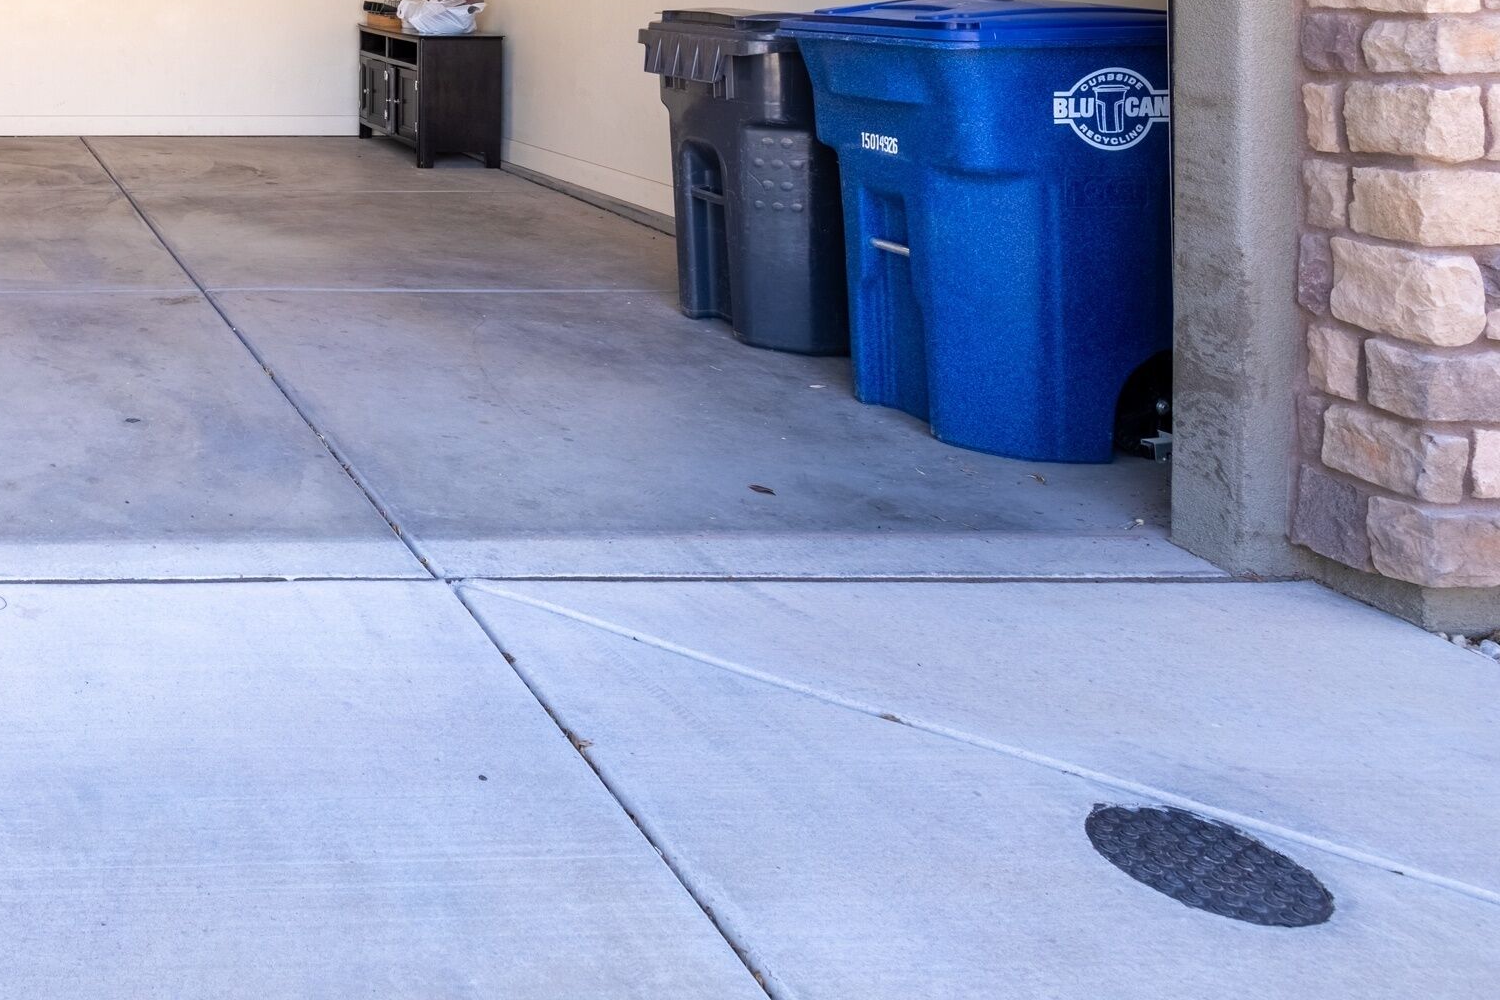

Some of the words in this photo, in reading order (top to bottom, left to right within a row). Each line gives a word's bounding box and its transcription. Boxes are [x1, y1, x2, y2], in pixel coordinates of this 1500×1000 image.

[1080, 73, 1143, 92] CURBSIDE
[1053, 97, 1095, 118] BLU
[861, 131, 898, 154] 15014926
[1079, 123, 1144, 145] RECYCLING
